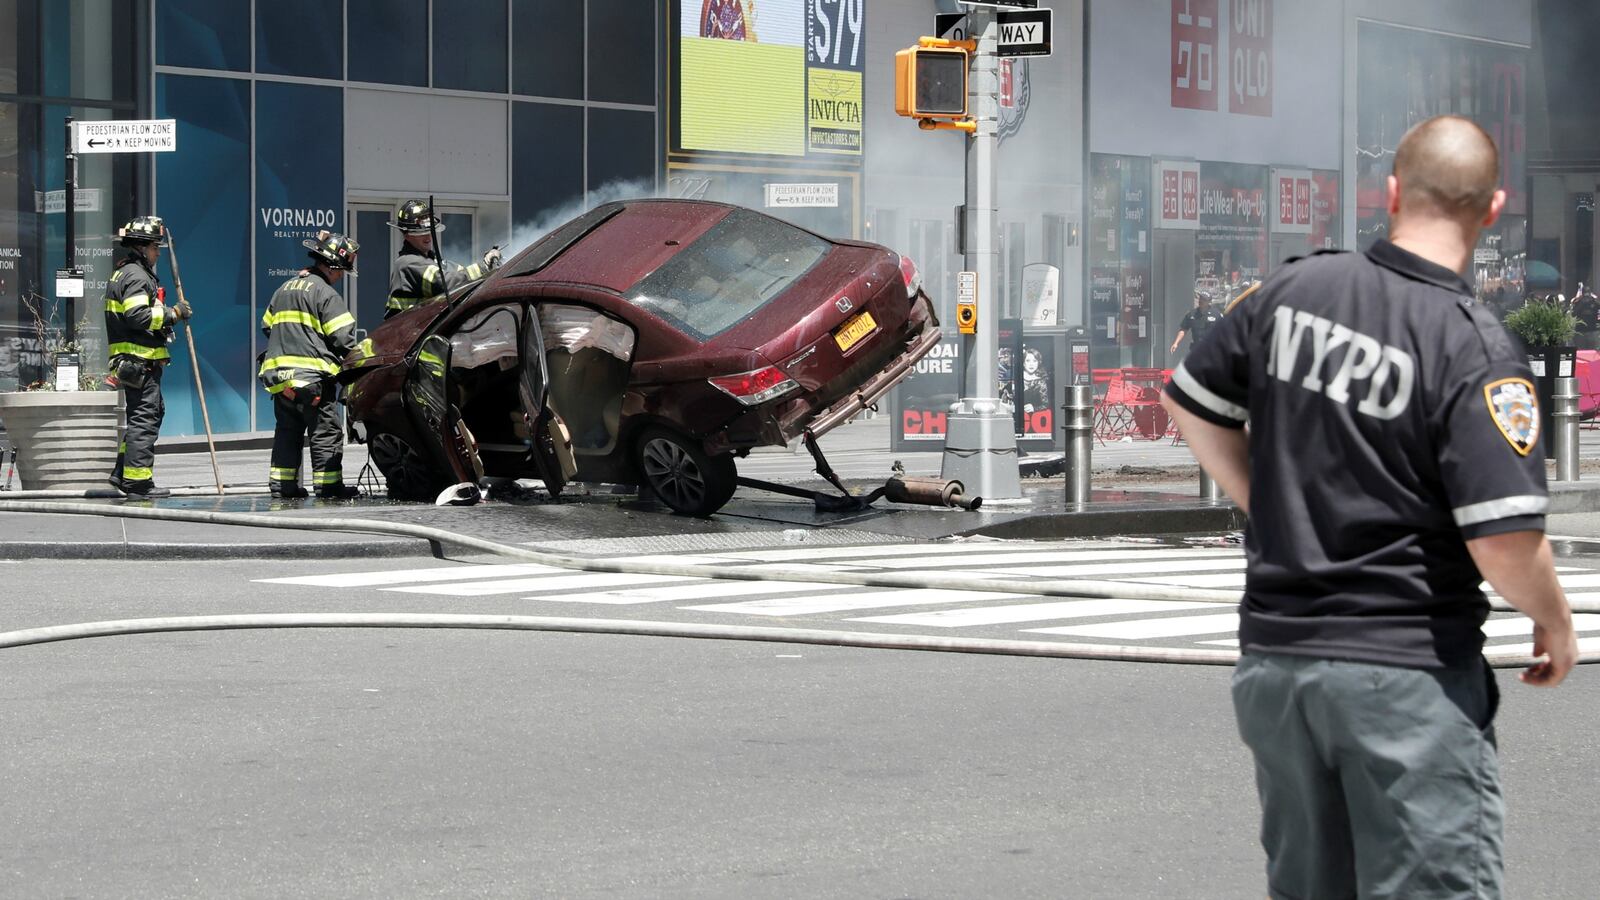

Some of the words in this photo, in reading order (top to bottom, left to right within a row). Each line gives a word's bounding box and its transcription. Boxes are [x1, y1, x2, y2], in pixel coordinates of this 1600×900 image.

[1001, 24, 1036, 43] WAY
[1234, 47, 1268, 104] QLO
[811, 98, 860, 123] INVICTA
[86, 125, 130, 135] PEDESTRIAN
[132, 125, 150, 134] FLOW
[152, 124, 171, 134] ZONE
[125, 138, 142, 147] KEEP
[144, 137, 171, 147] MOVING
[775, 186, 806, 194] PEDESTRIAN
[807, 186, 820, 194] FLOW
[822, 186, 835, 194] ZONE
[1183, 178, 1196, 194] UNI
[1183, 198, 1196, 216] QLO
[1199, 189, 1235, 215] LifeWear
[1236, 191, 1267, 224] Pop-Up
[261, 208, 335, 228] VORNADO
[93, 247, 114, 259] power
[1267, 305, 1415, 420] NYPD
